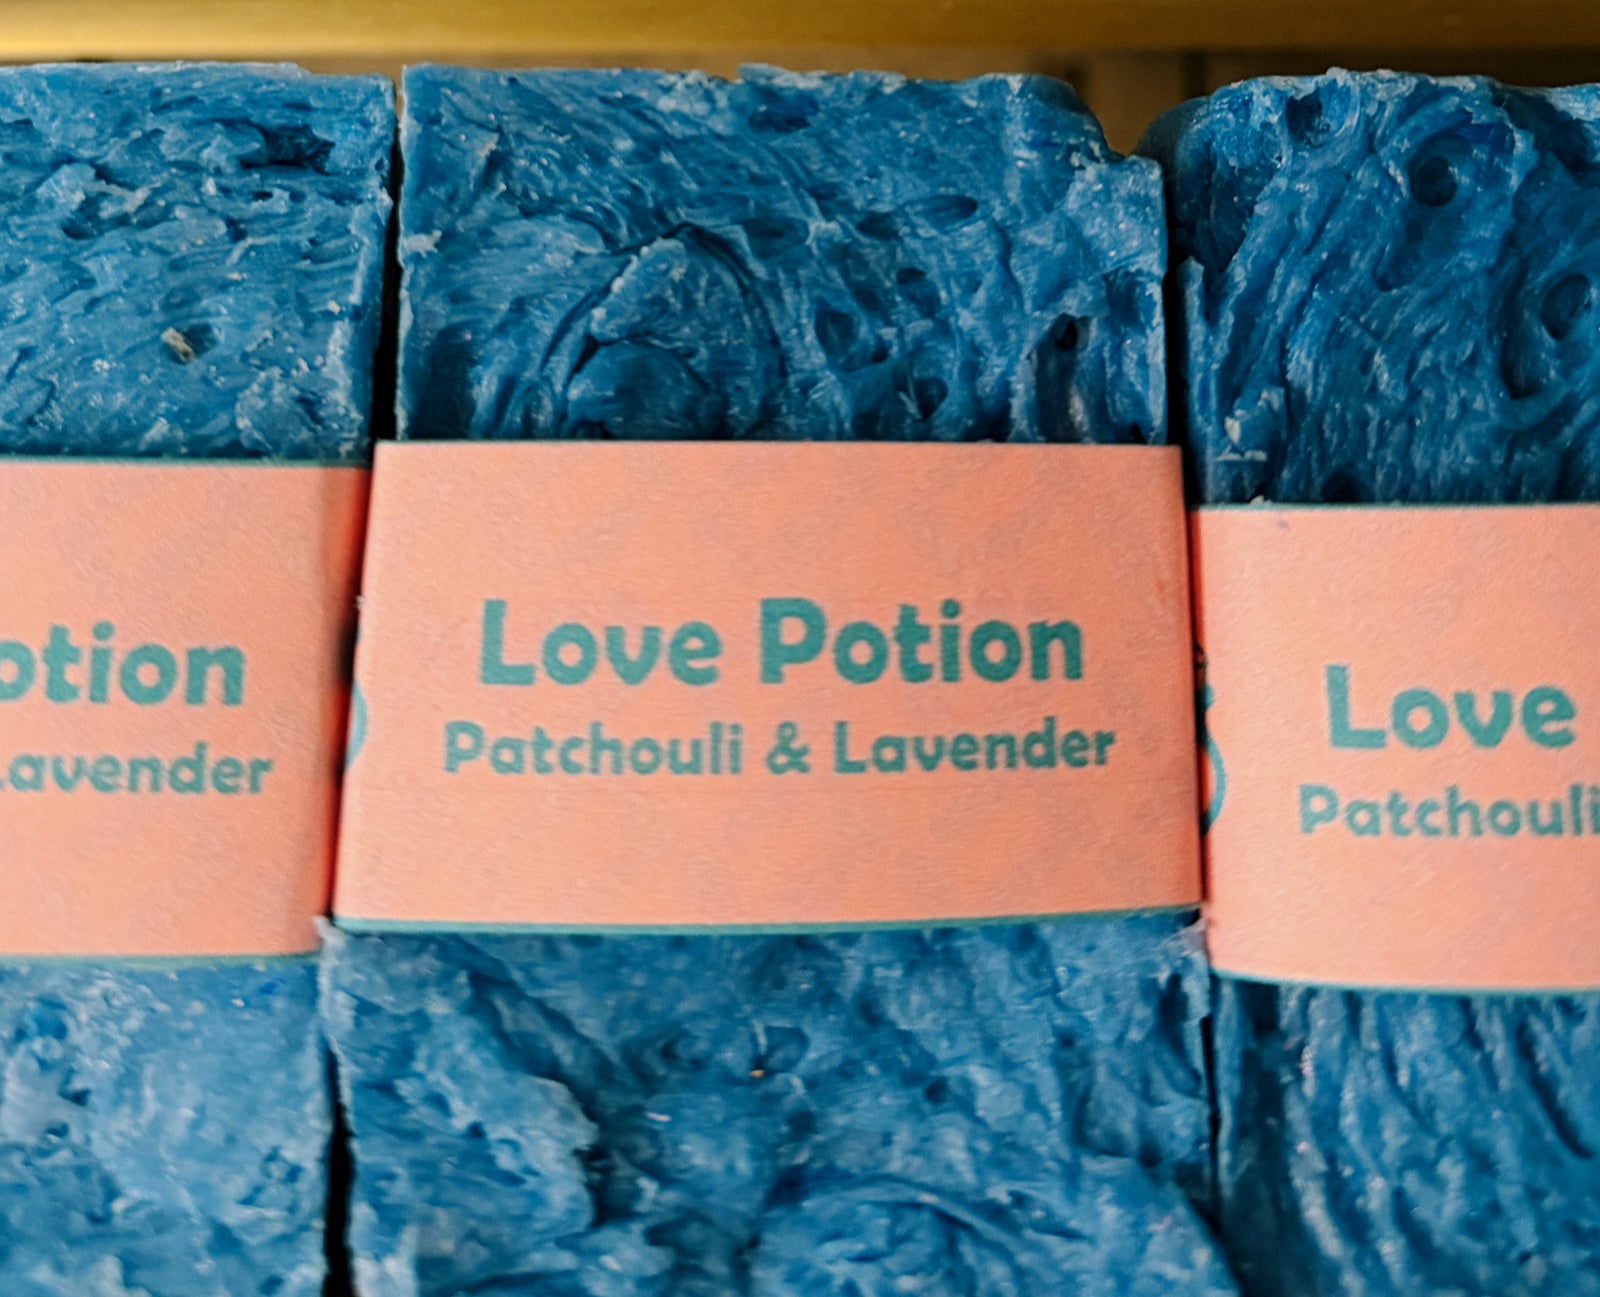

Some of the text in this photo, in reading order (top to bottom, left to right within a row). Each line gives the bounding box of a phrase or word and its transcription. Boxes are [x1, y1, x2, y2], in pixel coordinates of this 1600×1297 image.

[480, 598, 1085, 686] Love Potion
[1324, 663, 1577, 750] Love
[0, 741, 273, 796] avender
[443, 716, 1115, 775] Patchouli & Lavender
[1299, 783, 1600, 838] Patchouli
